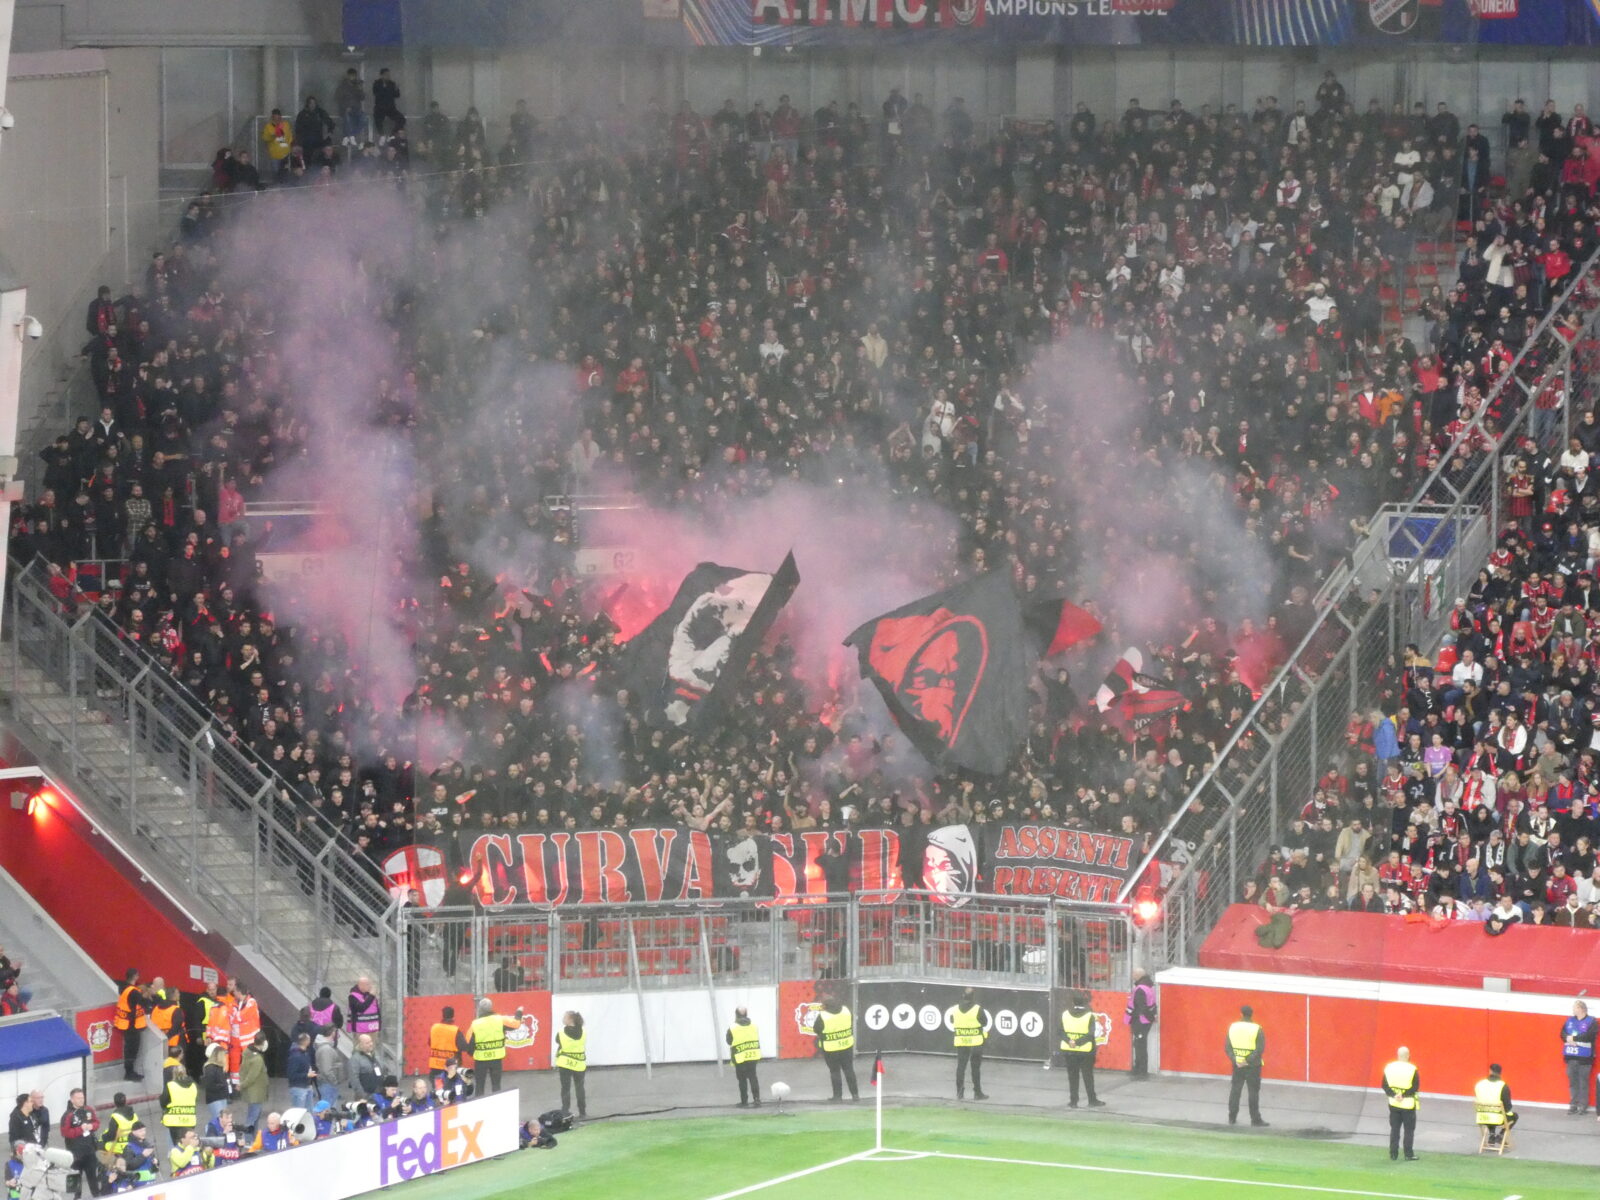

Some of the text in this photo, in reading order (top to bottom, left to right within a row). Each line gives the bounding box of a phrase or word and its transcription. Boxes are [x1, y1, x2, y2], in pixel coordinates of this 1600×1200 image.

[984, 0, 1079, 16] AMPIONS
[613, 551, 635, 570] G2
[996, 825, 1133, 870] ASSENTI
[470, 829, 724, 911] CURVA
[994, 866, 1127, 904] PRESENTI
[1565, 1045, 1579, 1055] 025
[380, 1107, 485, 1186] FedEx
